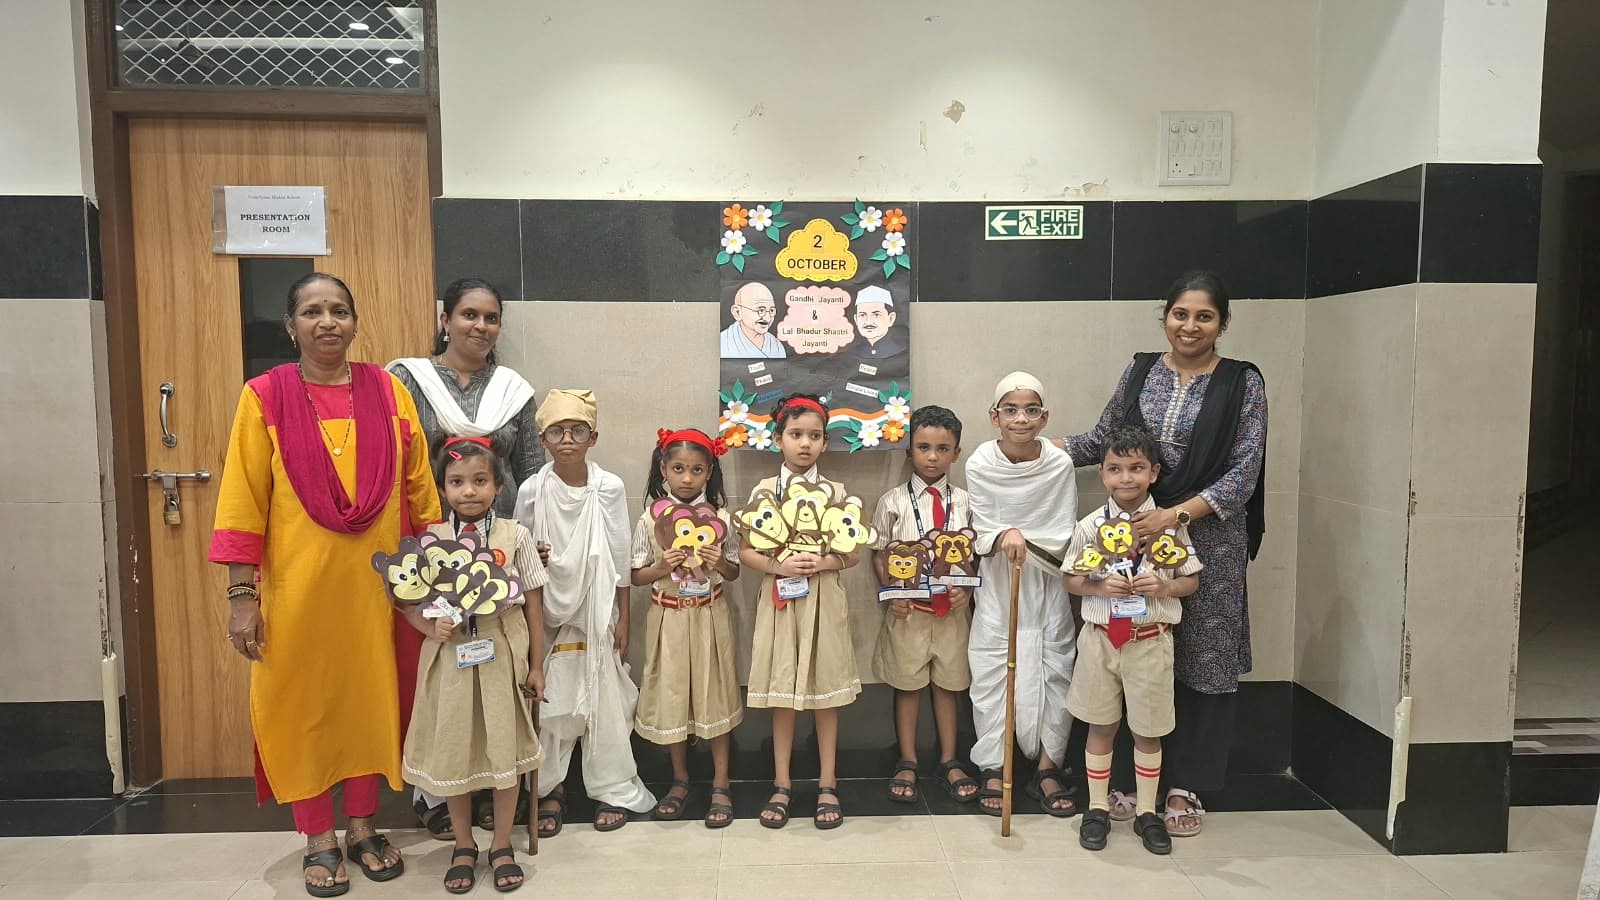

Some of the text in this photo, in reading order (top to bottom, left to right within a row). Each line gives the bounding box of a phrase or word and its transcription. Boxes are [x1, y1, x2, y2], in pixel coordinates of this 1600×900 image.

[1040, 210, 1078, 222] FIRE
[1040, 223, 1078, 235] EXIT
[813, 234, 823, 248] 2
[787, 258, 847, 271] OCTOBER
[789, 295, 844, 304] Gandhi Jayanti
[812, 310, 818, 320] &
[782, 327, 849, 336] Lal Bhadur Shastri
[802, 339, 828, 348] Jayanti
